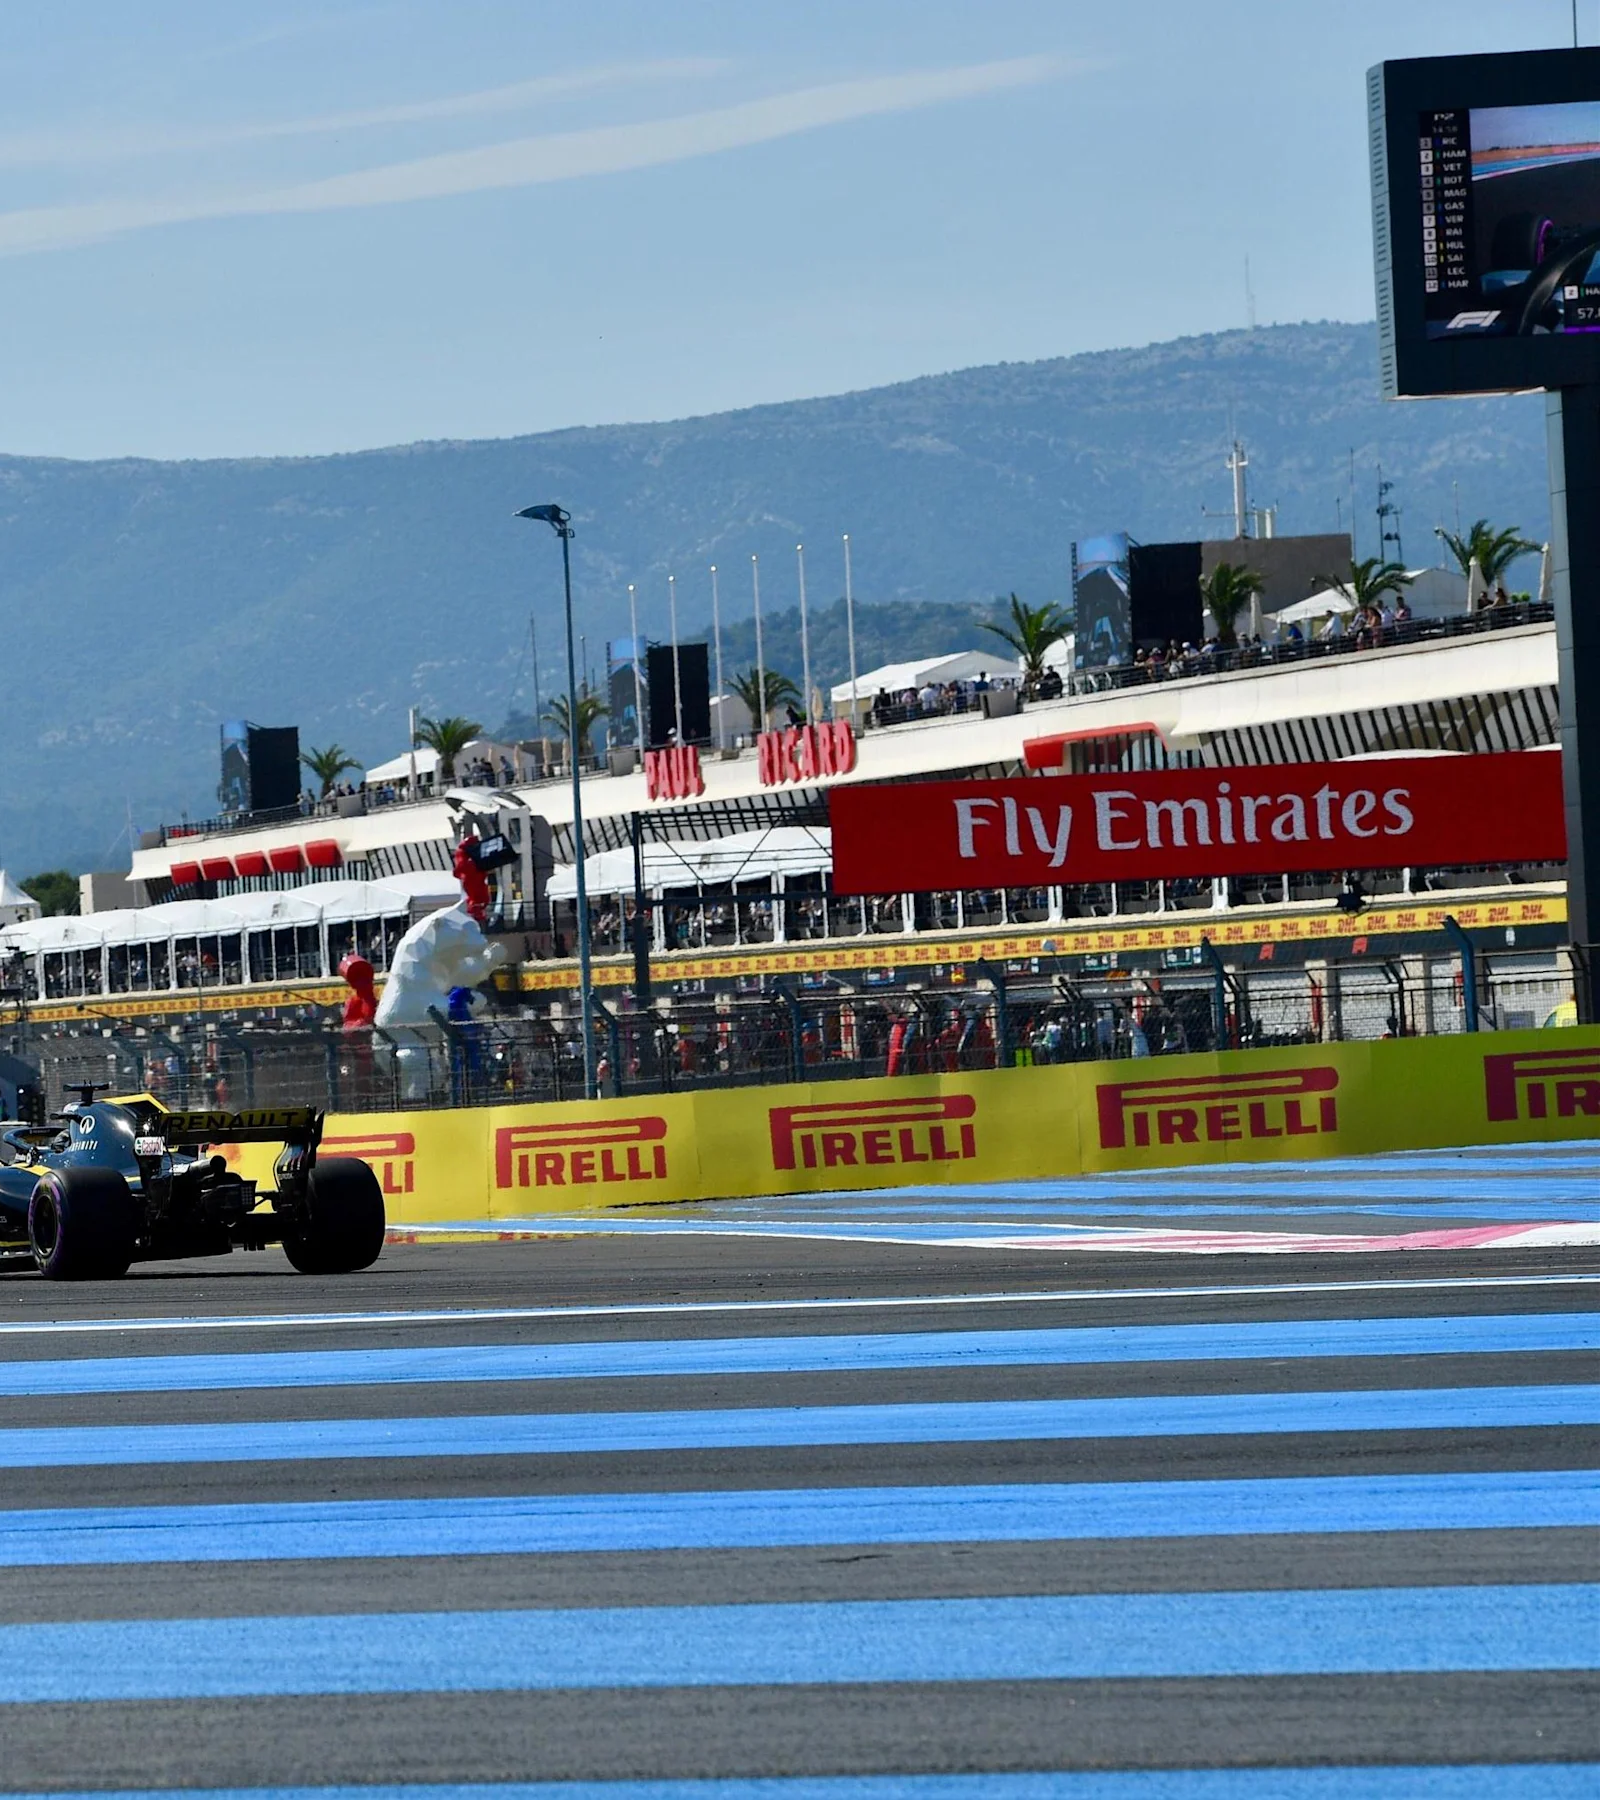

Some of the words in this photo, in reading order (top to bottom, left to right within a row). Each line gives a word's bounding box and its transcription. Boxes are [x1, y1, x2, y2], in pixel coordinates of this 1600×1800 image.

[1442, 150, 1467, 158] HAM
[1443, 163, 1462, 171] VET
[1443, 175, 1463, 184] BOT
[1443, 188, 1467, 198] MAG
[1444, 202, 1465, 210] GAS
[1445, 215, 1464, 223] VER
[1445, 228, 1463, 236] RAI
[1446, 241, 1465, 250] HUL
[1446, 253, 1463, 263] SAI
[1447, 267, 1466, 276] LEC
[1448, 279, 1469, 288] HAR
[1585, 287, 1600, 296] HA
[644, 745, 705, 802] PAUL
[757, 717, 857, 787] RICARD
[953, 796, 1073, 868] Fly
[1091, 781, 1414, 851] Emirates
[1096, 1066, 1340, 1149] PIRELLI
[167, 1111, 300, 1132] RENAULT
[769, 1094, 977, 1170] PIRELLI
[496, 1116, 668, 1189] PIRELLI
